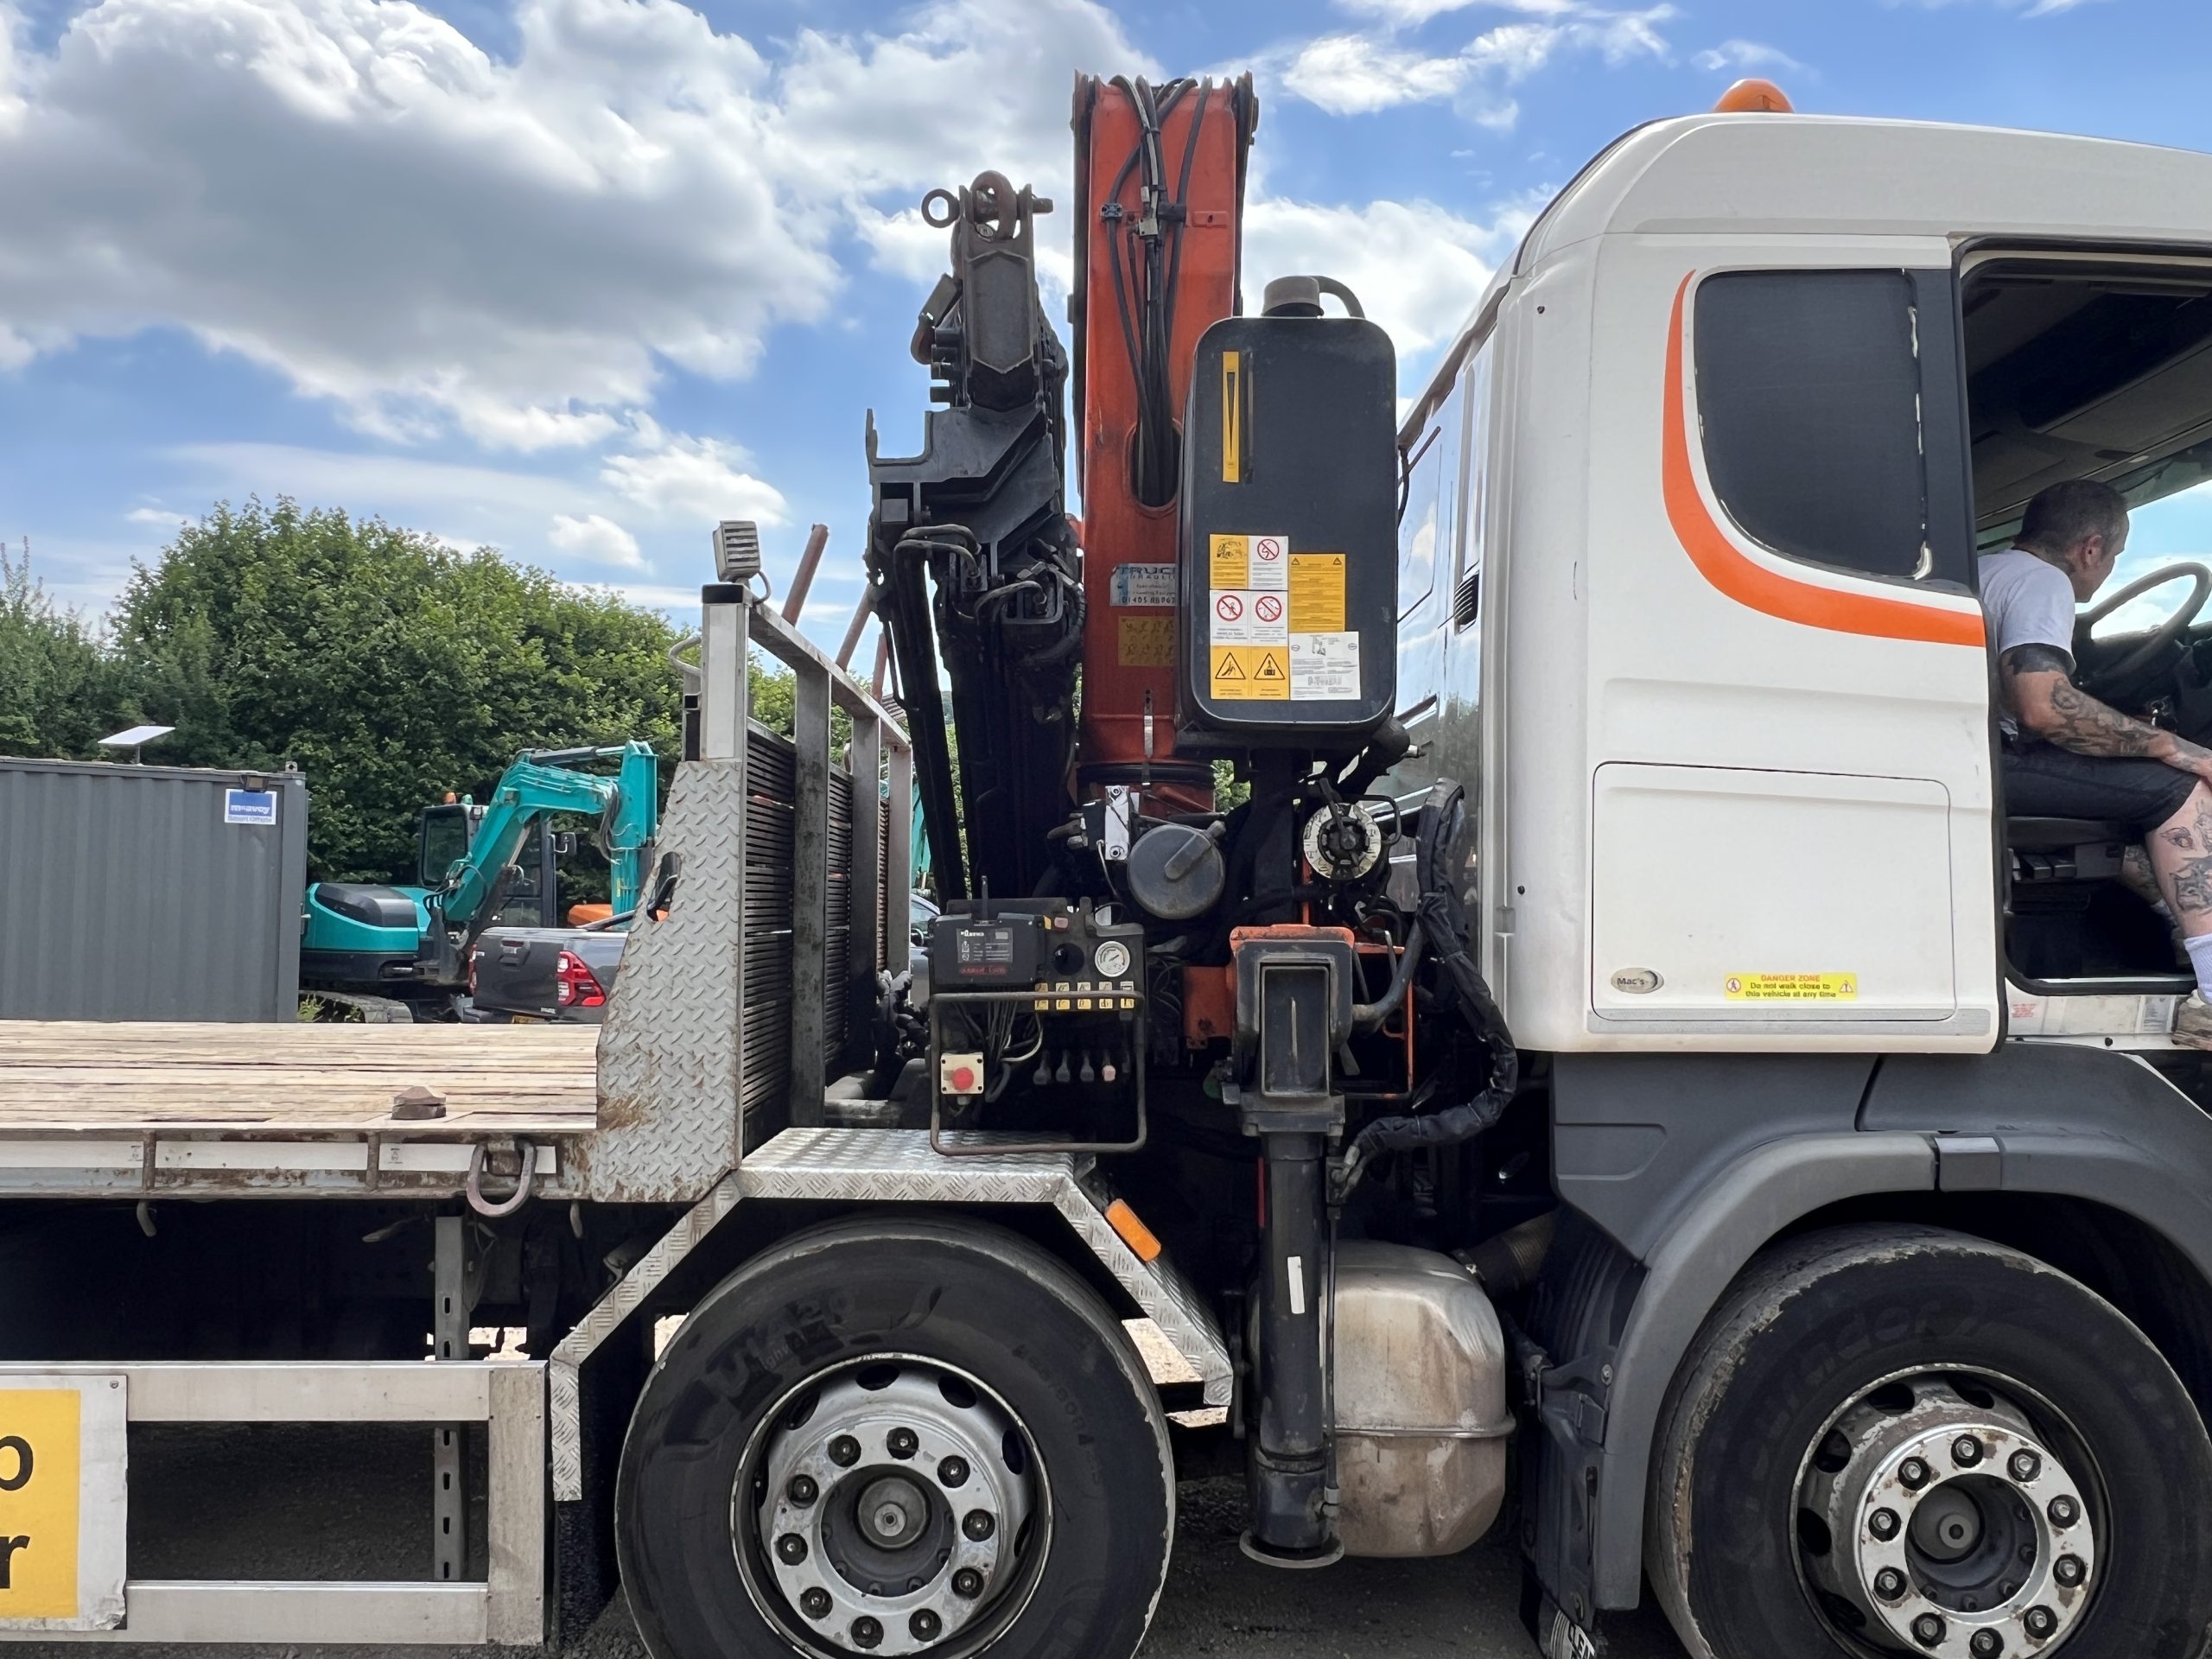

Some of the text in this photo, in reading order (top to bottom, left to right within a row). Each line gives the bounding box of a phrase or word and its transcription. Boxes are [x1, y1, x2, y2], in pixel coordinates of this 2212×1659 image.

[1120, 566, 1175, 575] TRUC
[1760, 974, 1821, 982] DANGER ZONE
